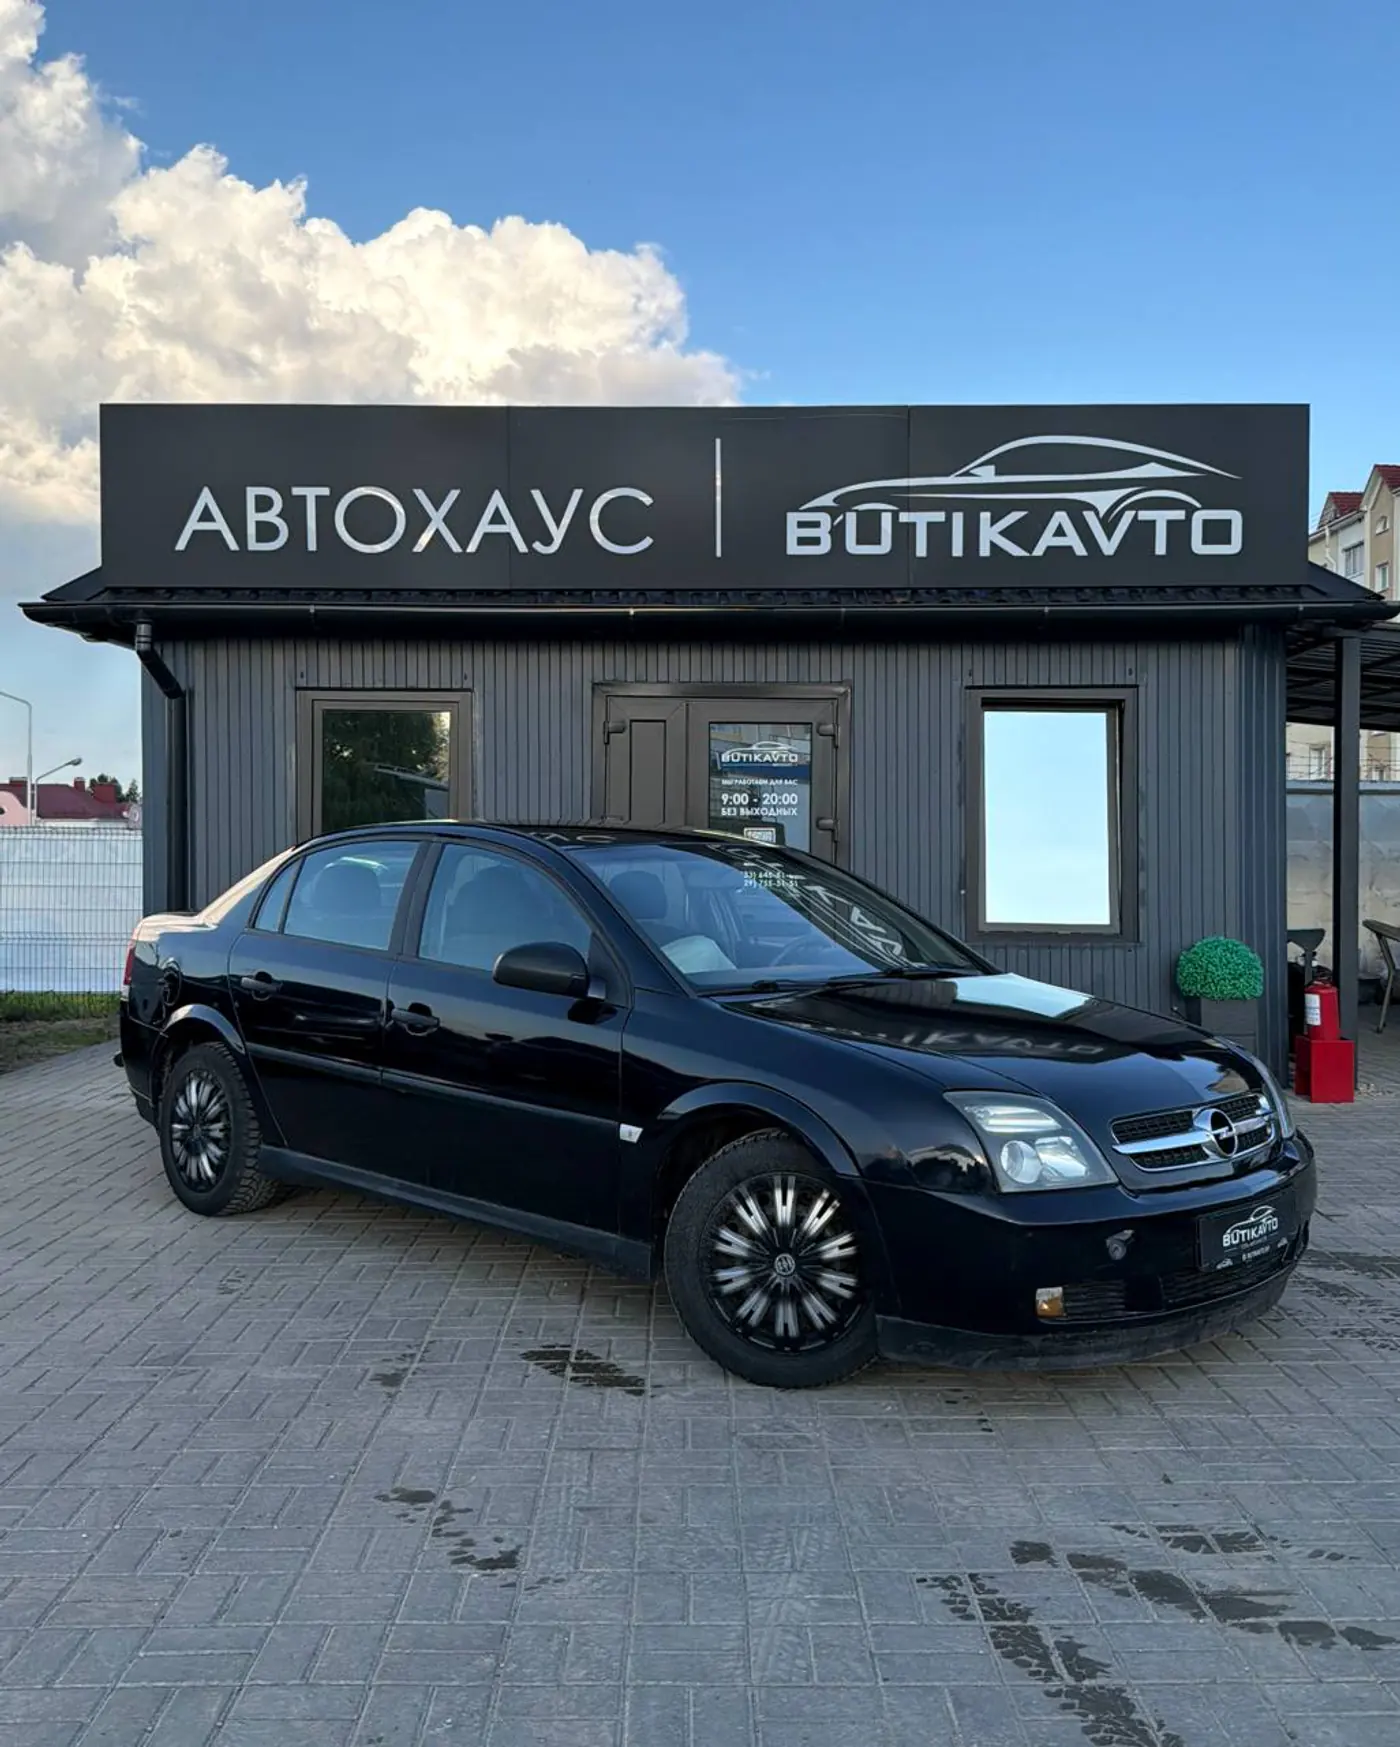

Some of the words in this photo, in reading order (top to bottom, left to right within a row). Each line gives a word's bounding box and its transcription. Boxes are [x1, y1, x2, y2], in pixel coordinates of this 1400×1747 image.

[174, 486, 654, 554] АВТОХАУС
[785, 509, 1243, 557] BUTIKAVTO
[721, 753, 798, 763] BUTIKAVTO
[721, 793, 749, 805] 9:00
[762, 793, 798, 805] 20:00
[721, 808, 737, 816] БЕЗ
[740, 808, 798, 816] ВЫХОДНЫХ
[1222, 1217, 1278, 1247] BUTIKAVTO
